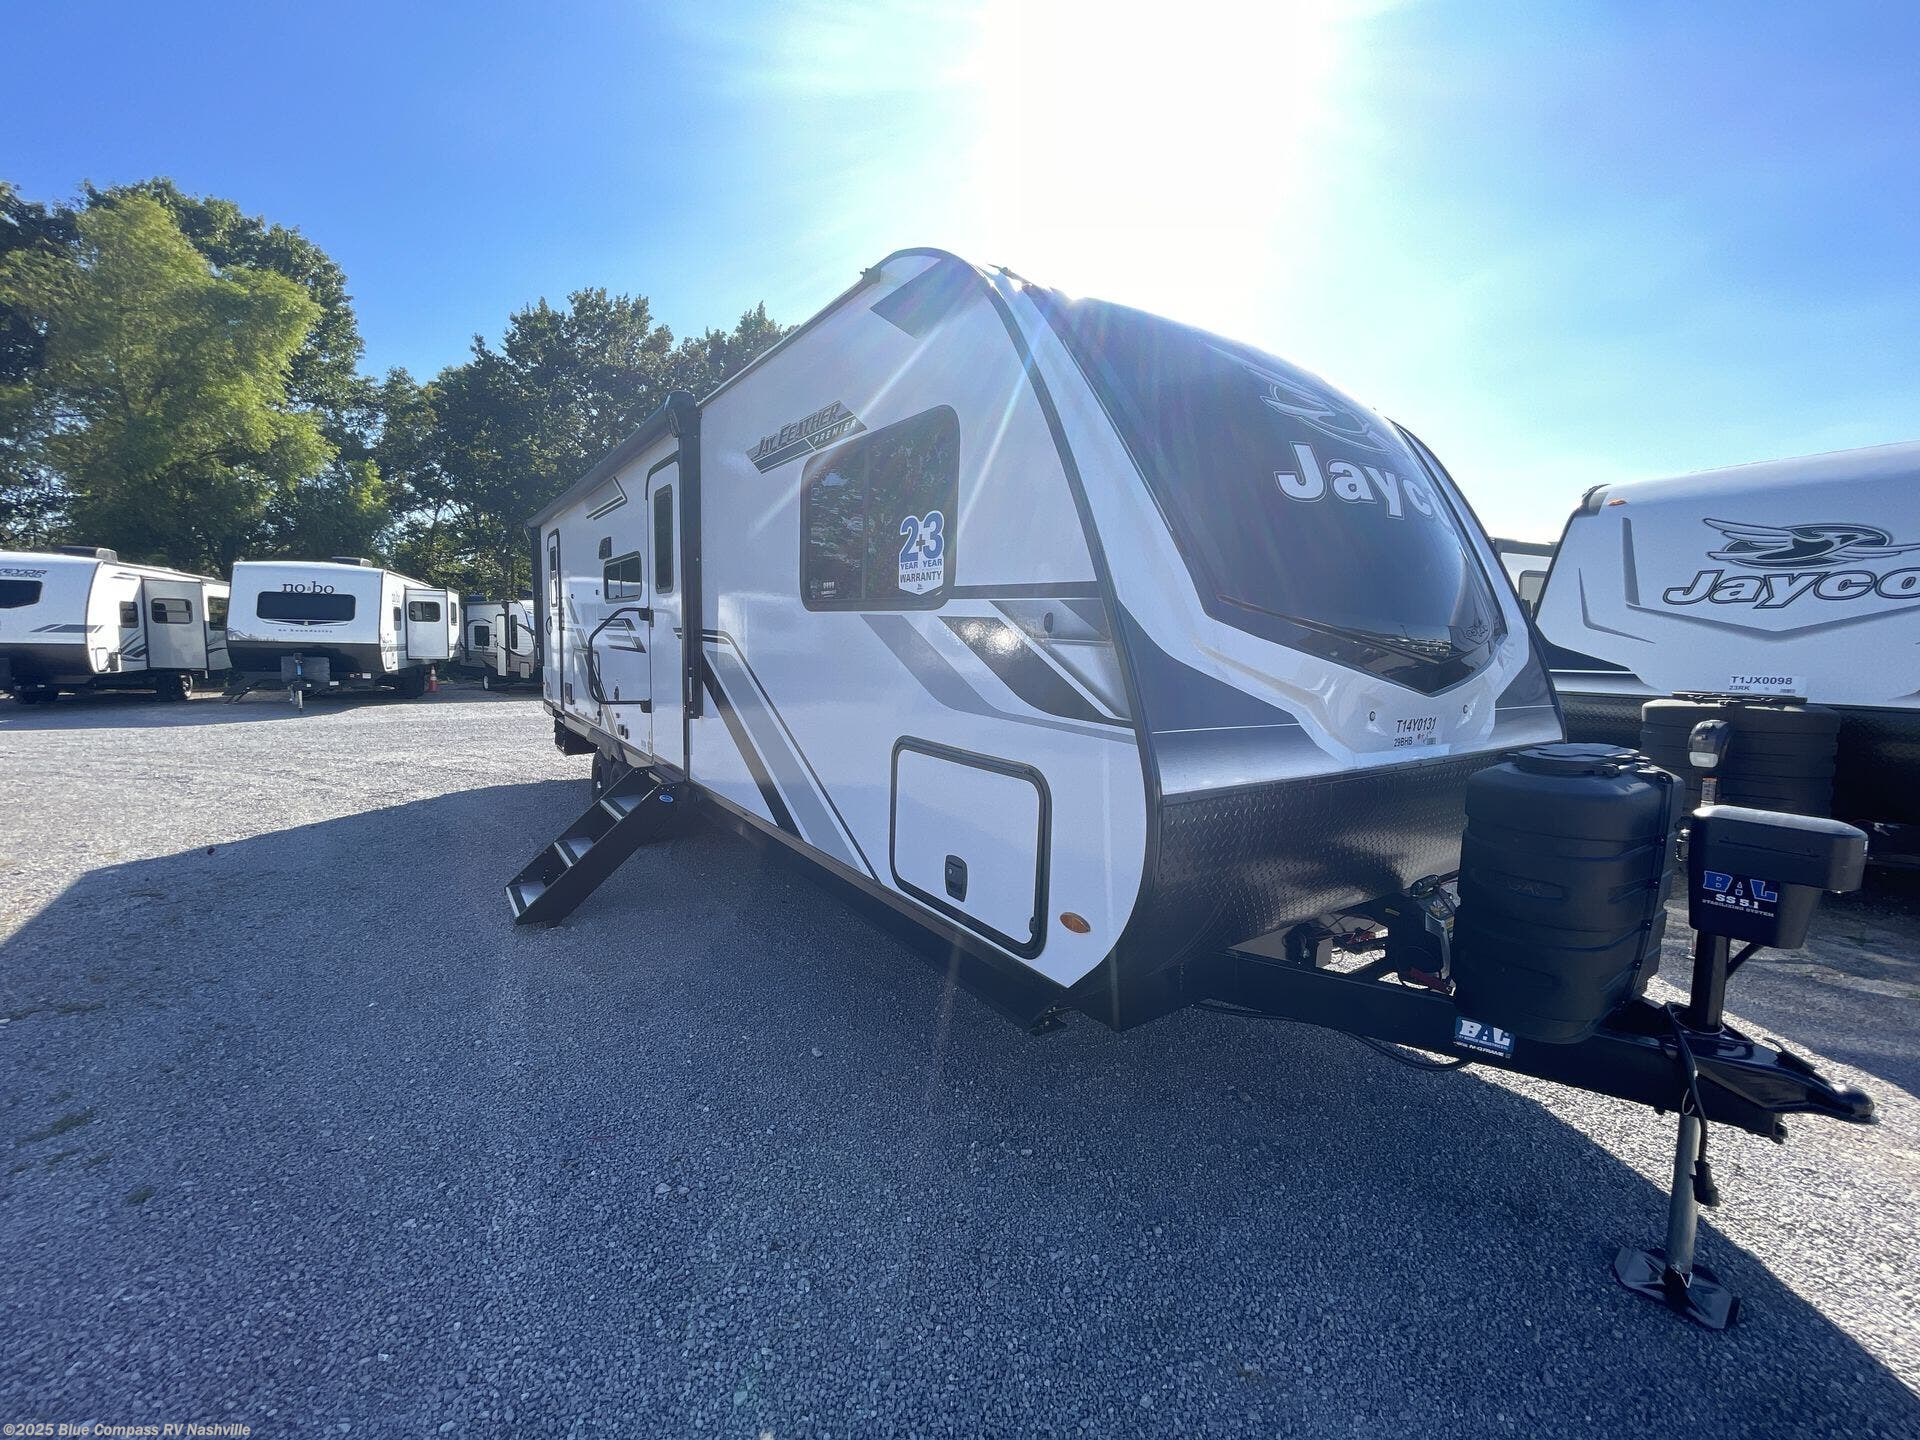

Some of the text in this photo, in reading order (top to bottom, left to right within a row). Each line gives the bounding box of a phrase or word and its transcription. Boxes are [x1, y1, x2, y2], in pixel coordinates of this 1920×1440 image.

[813, 419, 857, 445] PREMIER
[900, 558, 943, 570] YEAR YEAR
[900, 570, 942, 583] WARRANTY
[1663, 566, 1920, 609] Jayco
[1731, 676, 1793, 685] T1JX0098
[1396, 716, 1437, 733] T14Y0131
[1703, 870, 1778, 902] BAL
[1715, 893, 1736, 904] SS
[1702, 899, 1774, 917] STABILIZING SYSTEM
[1459, 1019, 1511, 1047] BAL
